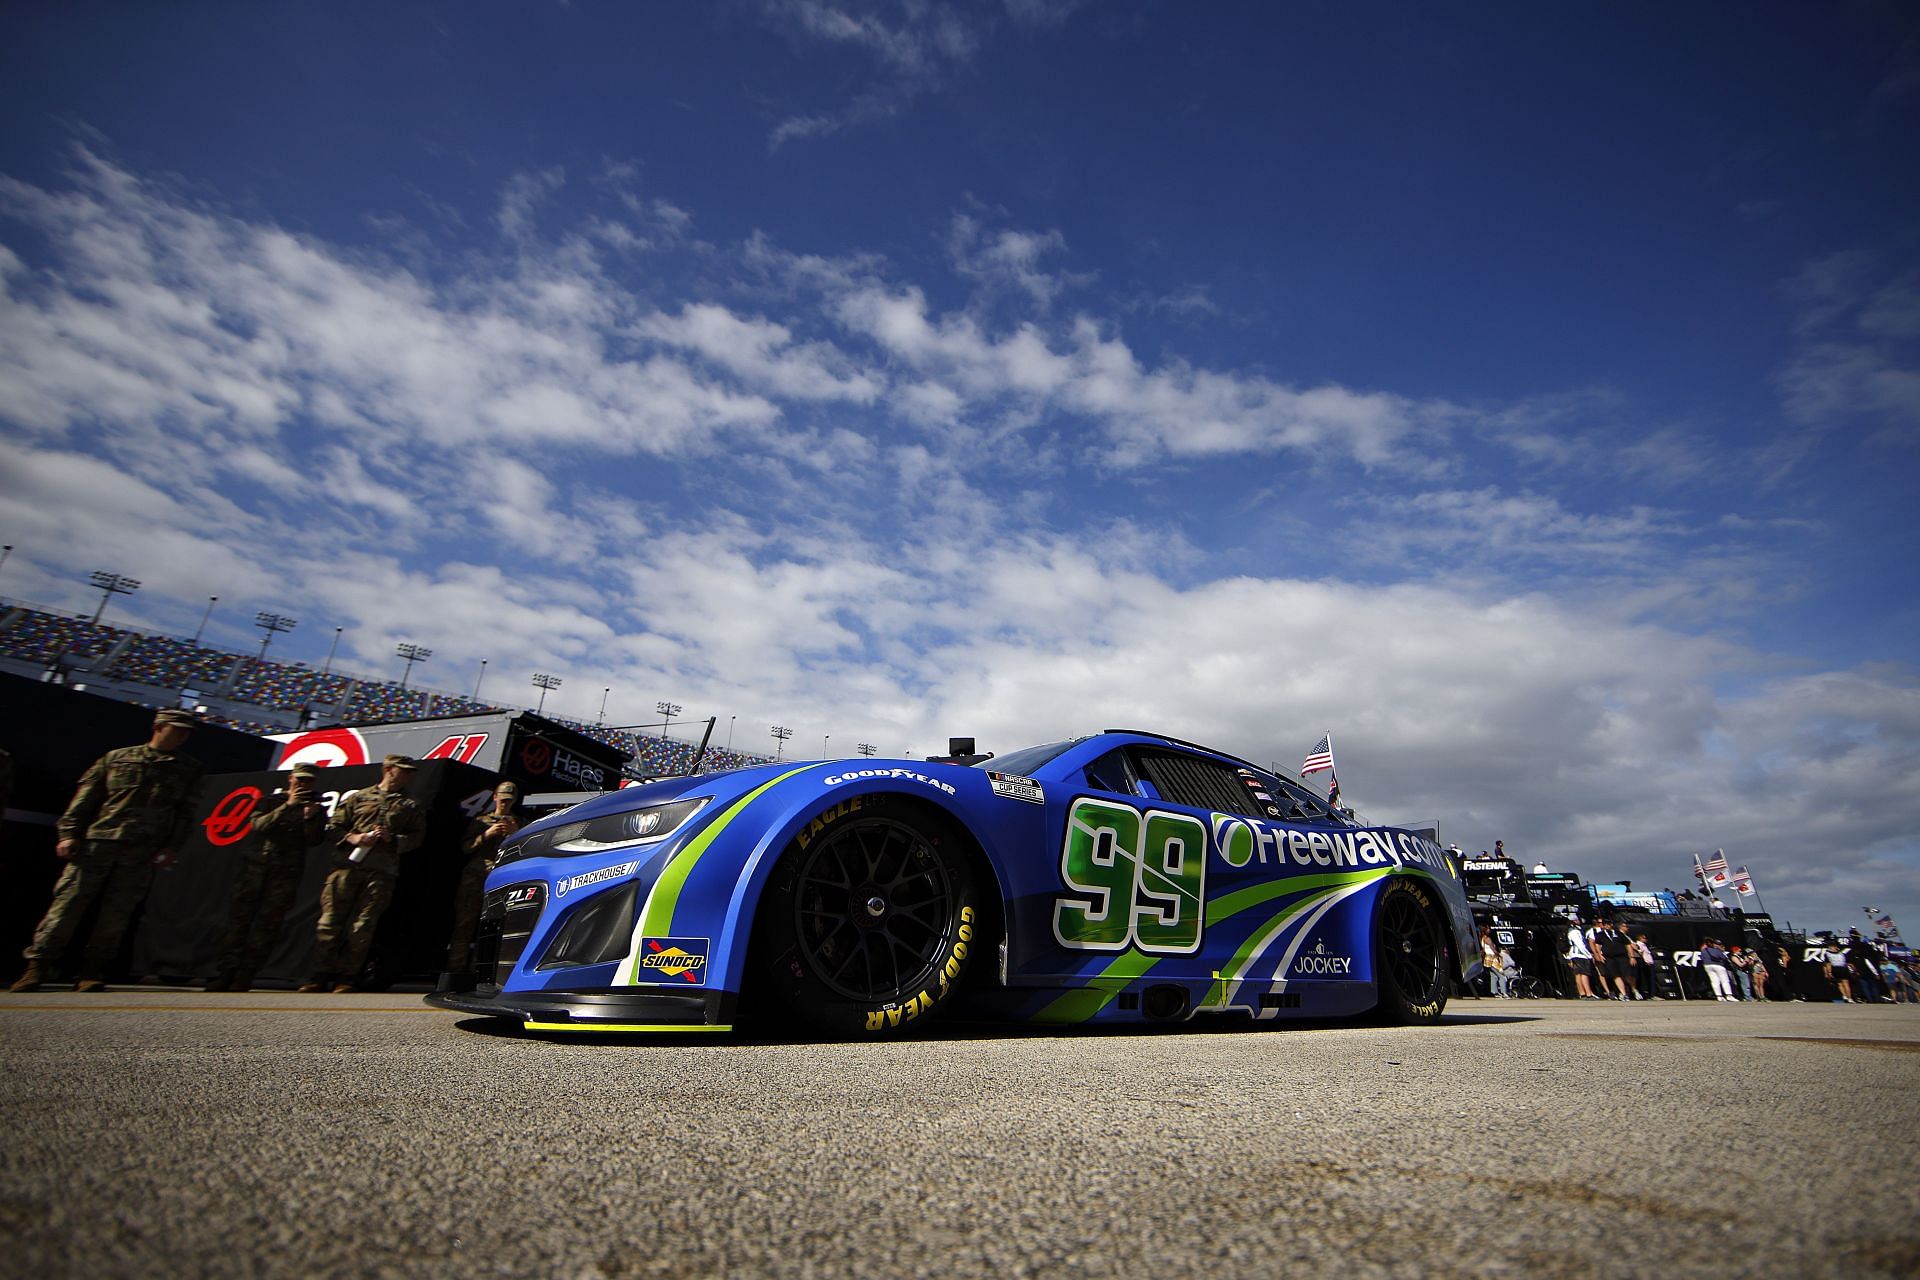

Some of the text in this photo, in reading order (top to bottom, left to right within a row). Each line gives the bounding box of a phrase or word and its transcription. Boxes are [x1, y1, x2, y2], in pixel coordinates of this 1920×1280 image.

[421, 733, 489, 764] 41
[551, 768, 582, 792] Factory
[553, 750, 605, 784] Haas
[1004, 774, 1034, 786] NASCAR
[823, 768, 957, 797] GOODYEAR
[999, 782, 1037, 797] CUP SERIES
[796, 796, 863, 850] EAGLE
[1243, 818, 1449, 872] Freeway.com
[573, 863, 628, 889] TRACKHOUSE
[1053, 797, 1208, 954] 99
[1463, 860, 1509, 871] FASTENAL
[645, 955, 703, 968] SUNOCO
[865, 906, 975, 1031] GOODYEAR
[1294, 956, 1351, 974] JOCKEY
[1411, 1001, 1439, 1017] EAGLE
